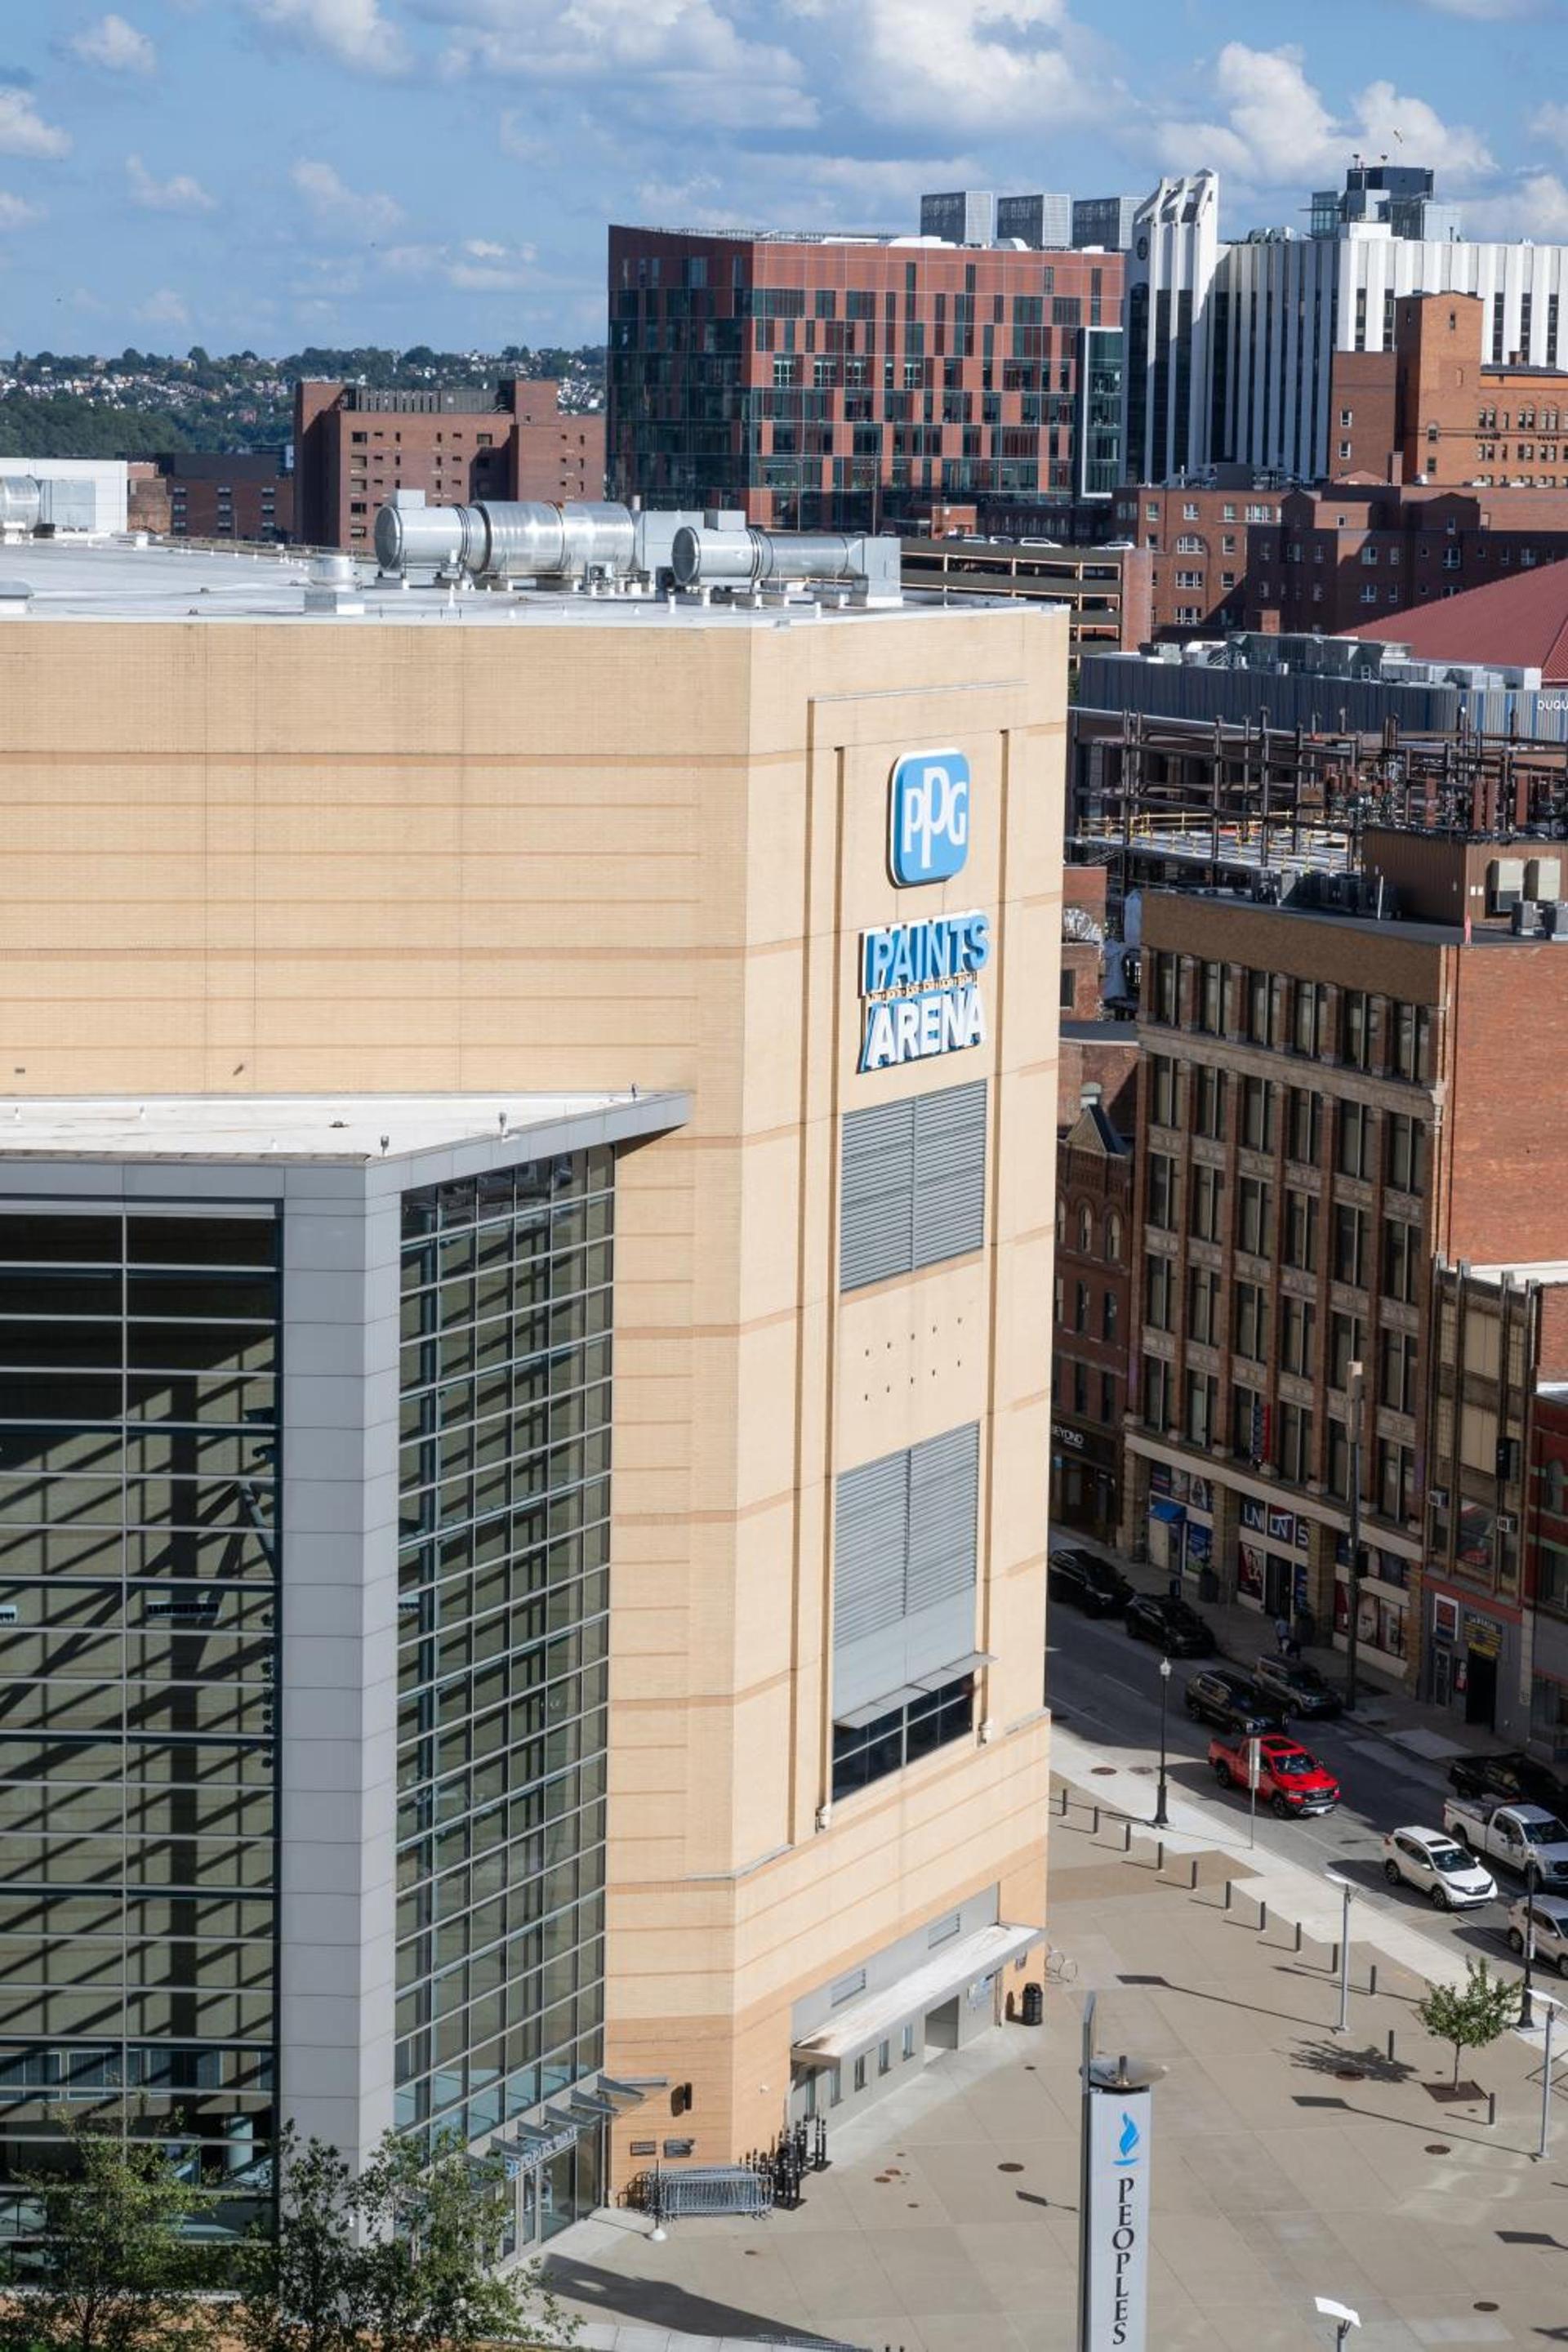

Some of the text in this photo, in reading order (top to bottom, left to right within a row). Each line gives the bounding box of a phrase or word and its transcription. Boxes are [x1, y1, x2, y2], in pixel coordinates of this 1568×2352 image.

[903, 765, 967, 868] PPG
[862, 911, 991, 994] PAINTS
[859, 986, 987, 1071] ARENA
[1112, 2177, 1134, 2345] PEOPLES
